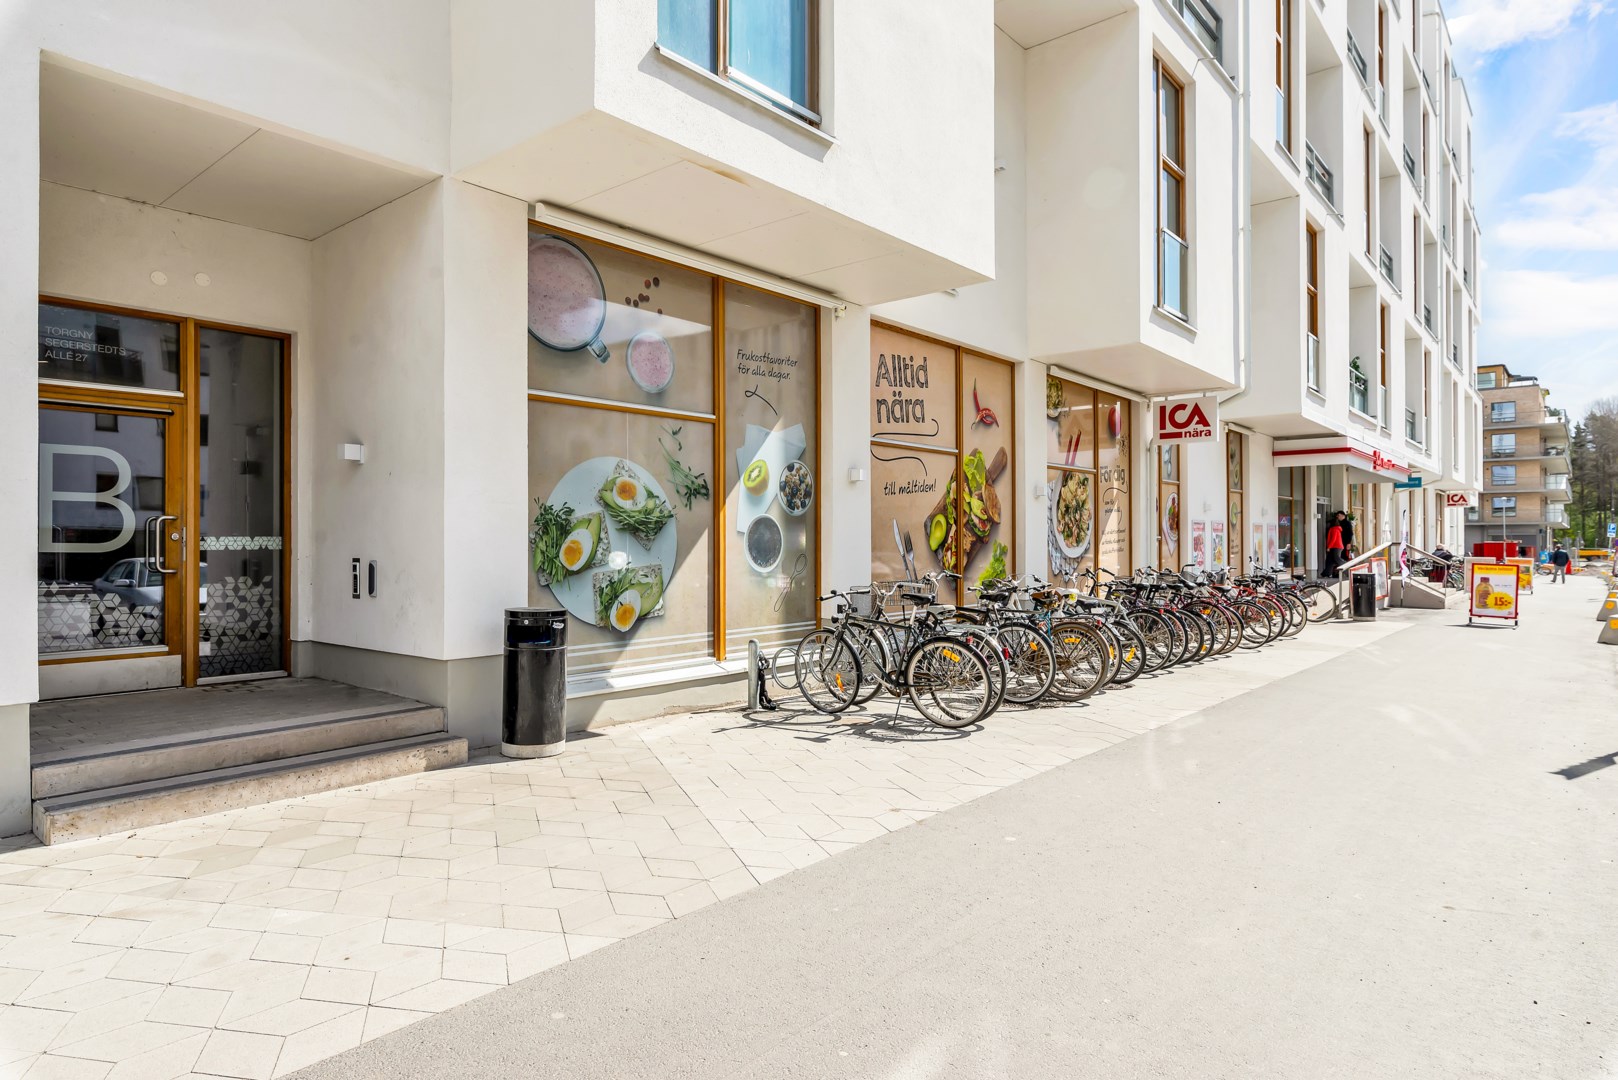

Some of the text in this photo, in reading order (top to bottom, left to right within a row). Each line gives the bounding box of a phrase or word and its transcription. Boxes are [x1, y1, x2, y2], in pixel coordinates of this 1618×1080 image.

[46, 326, 94, 340] TORGNY
[45, 338, 126, 356] SEGERSTEDTS
[45, 350, 88, 362] ALLÉ 27
[737, 349, 798, 367] Frukostfavoriter
[738, 362, 790, 382] för alla dagar.
[875, 354, 928, 388] Alltid
[876, 390, 926, 424] nära
[1160, 402, 1211, 430] ICA
[1184, 428, 1212, 438] nära
[884, 478, 936, 496] till måltiden!
[39, 443, 136, 553] B
[1446, 494, 1468, 503] ICA
[1494, 596, 1512, 606] 15:-
